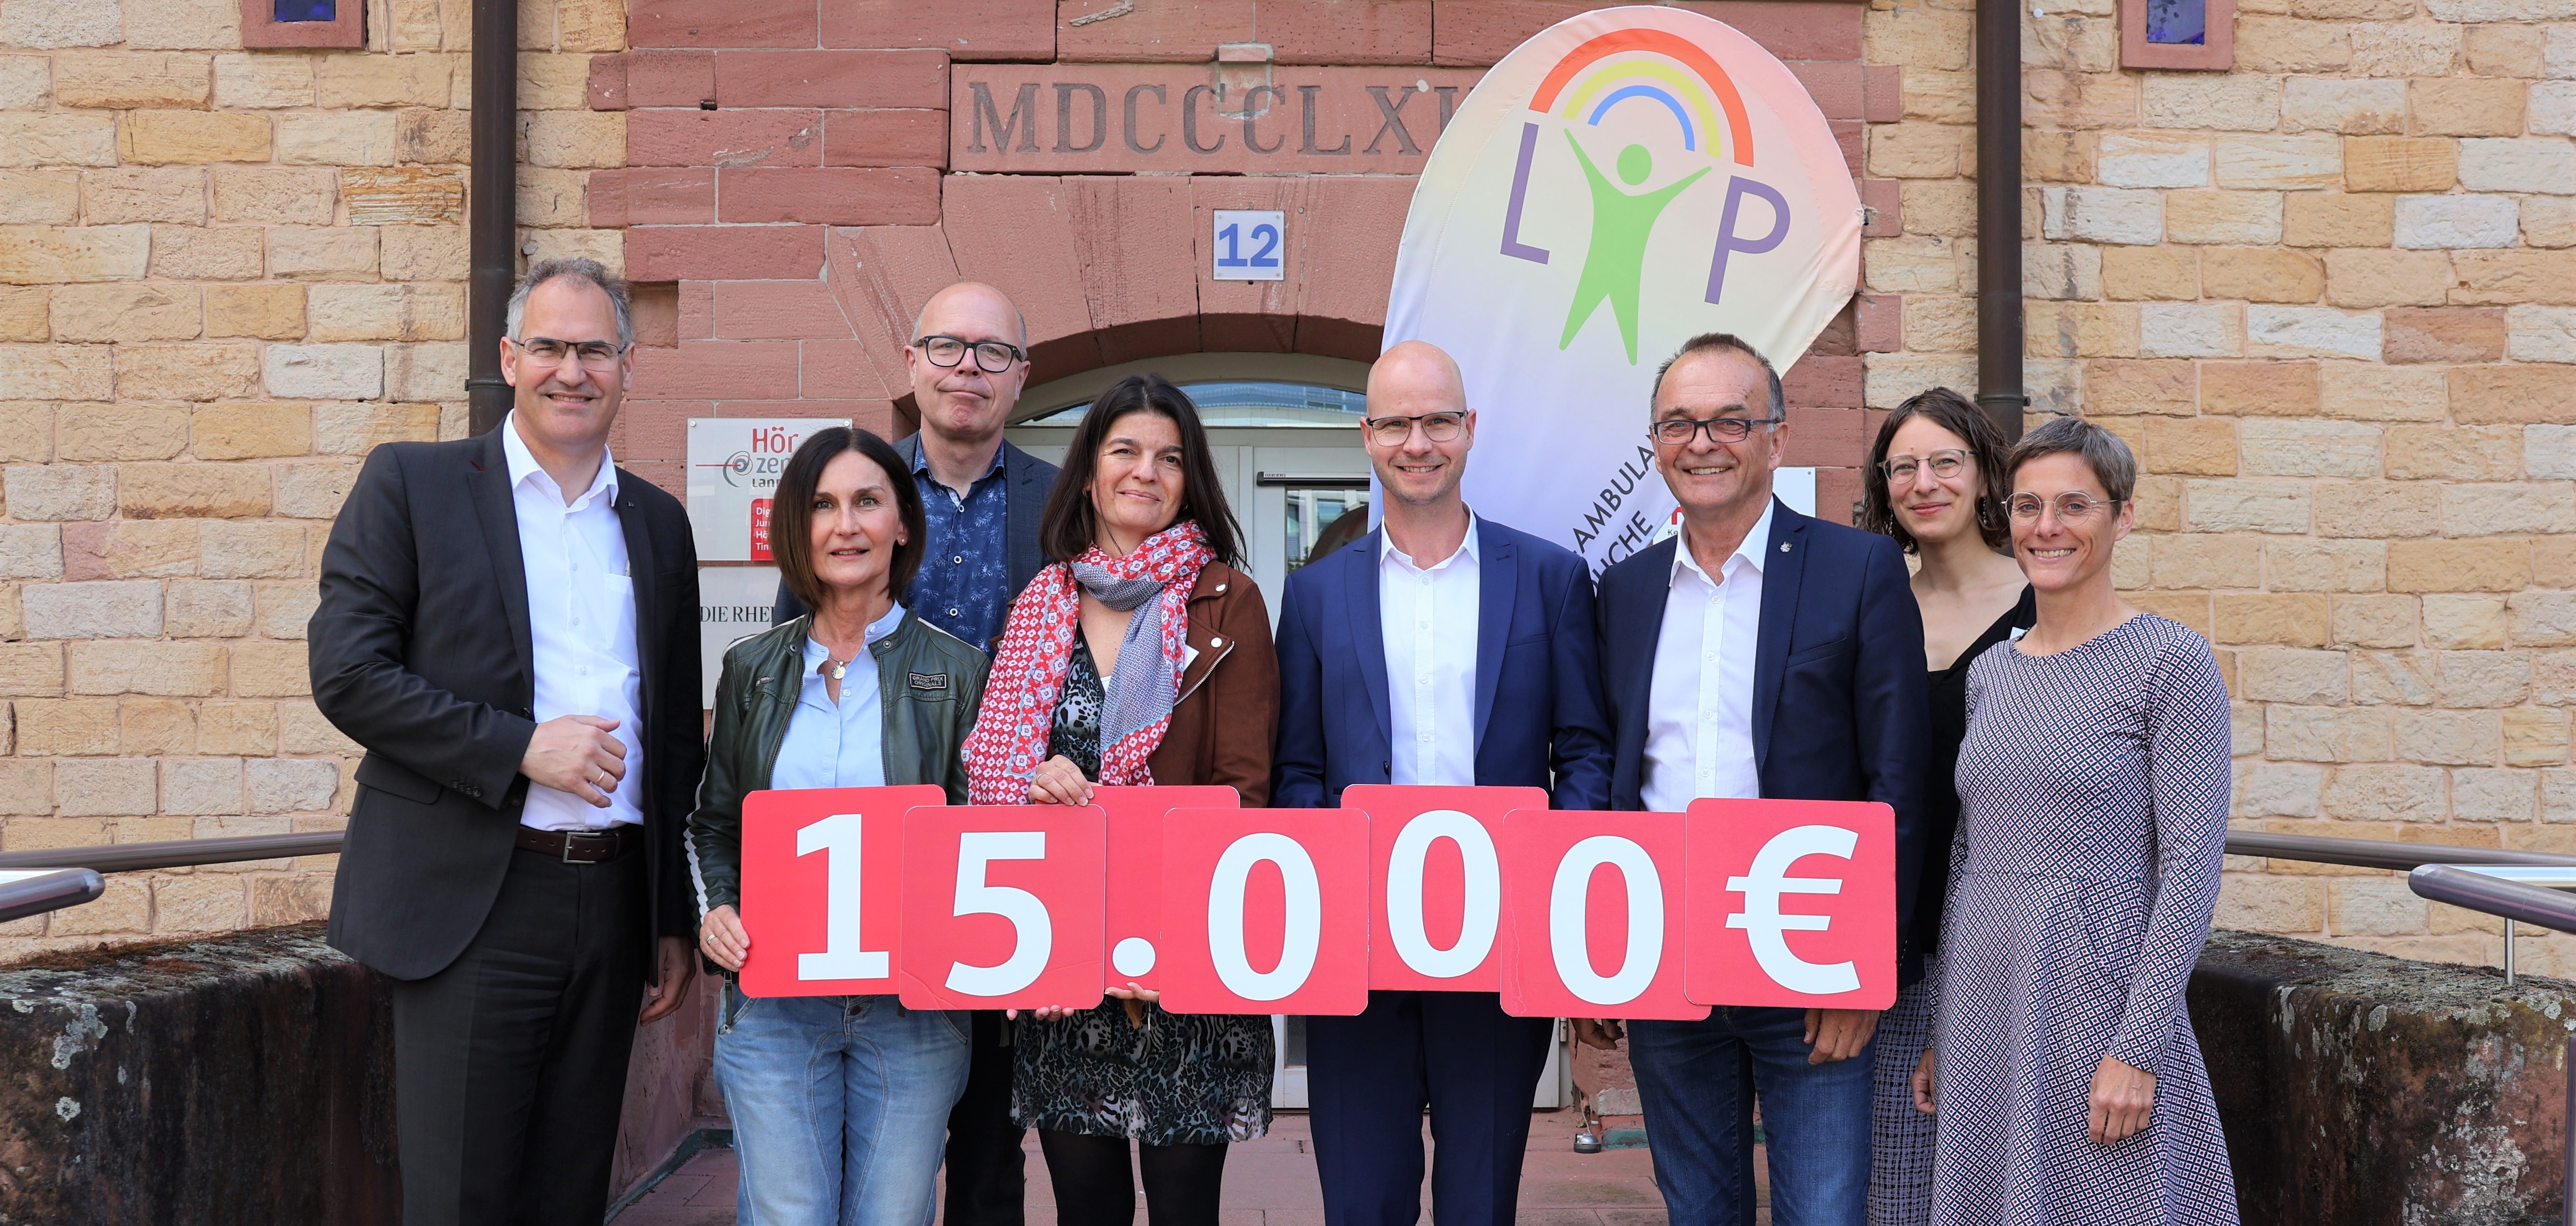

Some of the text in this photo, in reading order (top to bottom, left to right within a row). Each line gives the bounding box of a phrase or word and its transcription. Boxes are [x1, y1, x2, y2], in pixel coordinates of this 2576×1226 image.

[967, 82, 1473, 156] MDCCCLXI
[1217, 223, 1279, 268] 12
[752, 426, 799, 454] Hör
[1573, 435, 1655, 554] AMBULA
[700, 606, 728, 622] DIE
